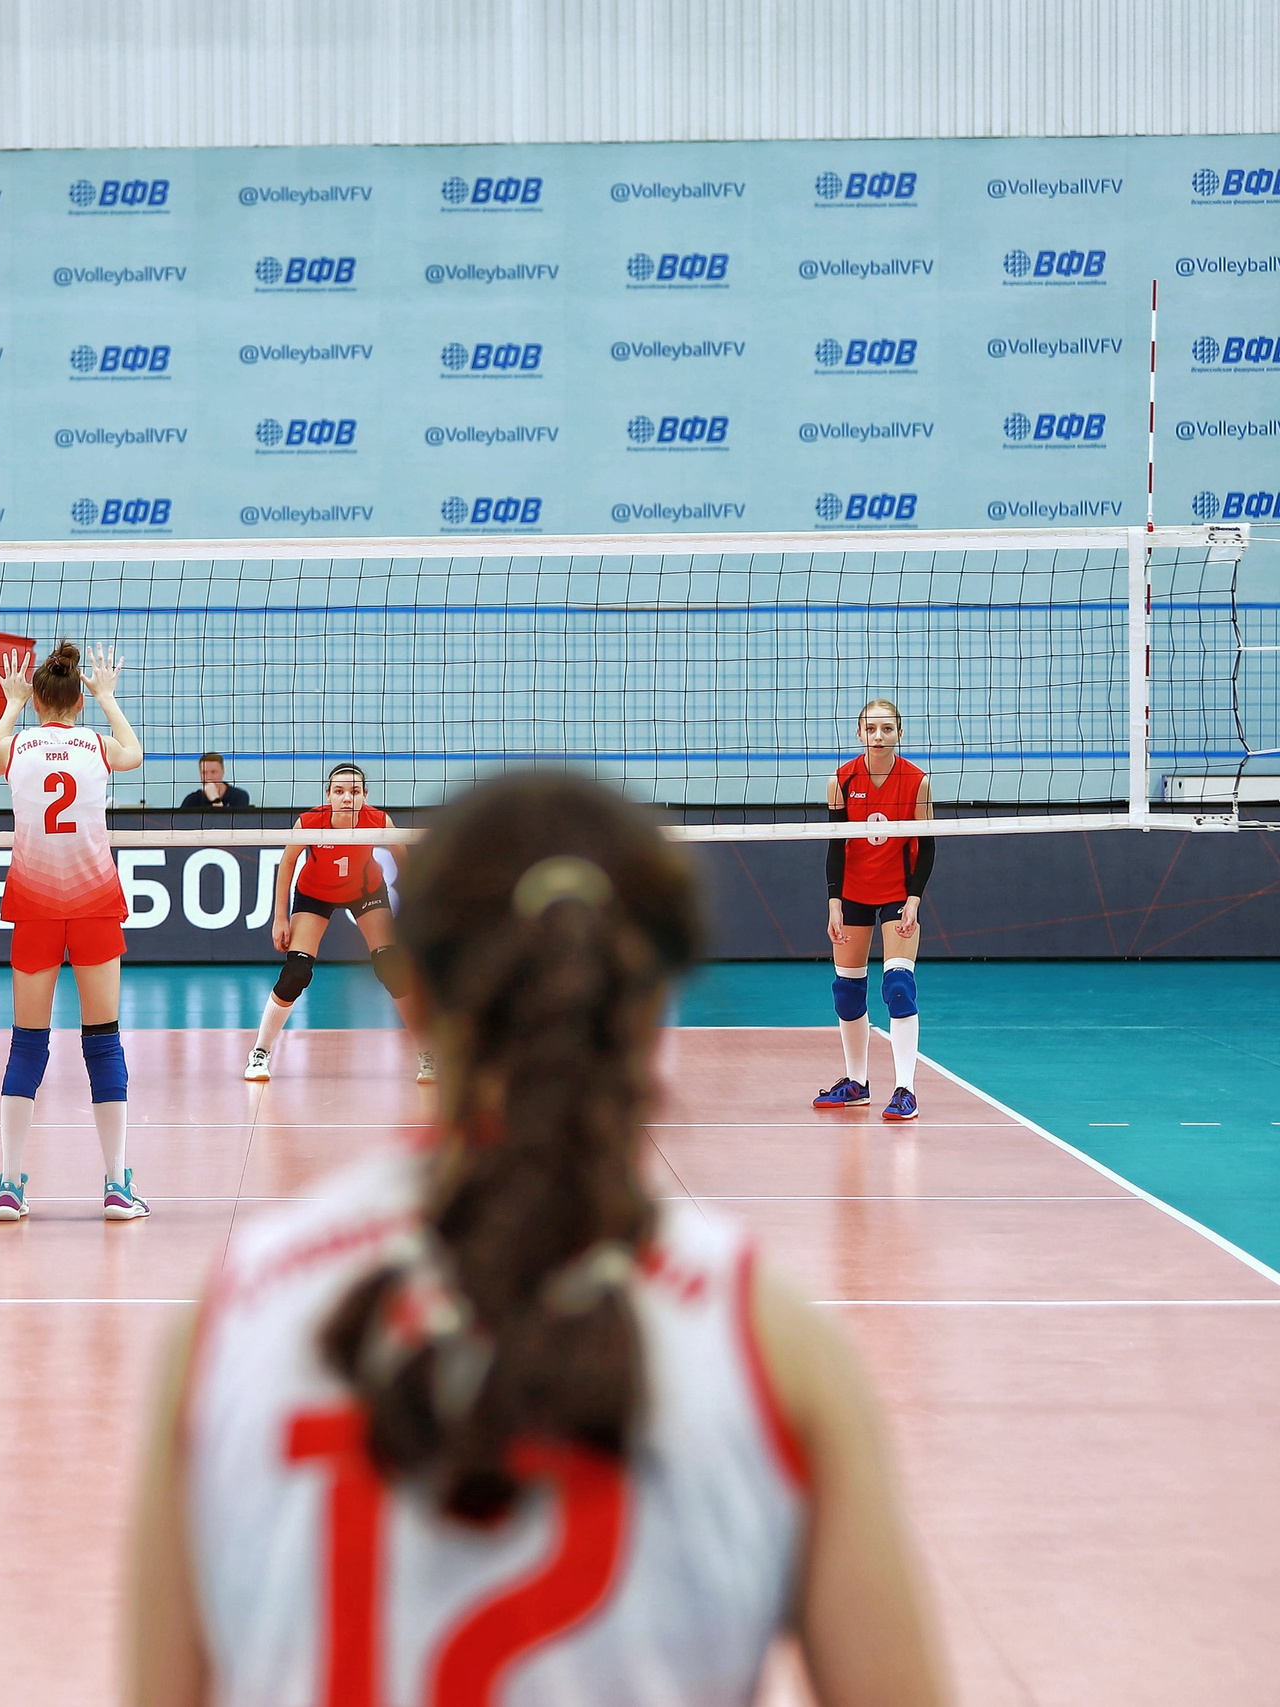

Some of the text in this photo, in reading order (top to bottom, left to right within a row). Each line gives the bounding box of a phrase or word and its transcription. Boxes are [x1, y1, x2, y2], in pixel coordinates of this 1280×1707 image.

[98, 179, 170, 207] ВФВ
[238, 186, 372, 206] @VolleyballVFV
[471, 177, 543, 205] ВФВ
[610, 182, 746, 203] @VolleyballVFV
[845, 171, 918, 199] ВФВ
[987, 178, 1123, 199] @VolleyballVFV
[284, 256, 357, 285] ВФВ
[424, 264, 559, 285] @VolleyballVFV
[656, 253, 729, 281] ВФВ
[798, 258, 934, 280] @VolleyballVFV
[1033, 250, 1107, 278] ВФВ
[53, 266, 187, 287] @VolleyballVFV
[99, 345, 171, 373] ВФВ
[239, 344, 373, 365] @VolleyballVFV
[470, 343, 543, 371] ВФВ
[610, 340, 745, 362] @VolleyballVFV
[844, 338, 918, 367] ВФВ
[987, 337, 1123, 358] @VolleyballVFV
[54, 427, 187, 448] @VolleyballVFV
[285, 418, 358, 446] ВФВ
[424, 426, 559, 447] @VolleyballVFV
[657, 415, 729, 444] ВФВ
[799, 422, 934, 443] @VolleyballVFV
[1033, 413, 1107, 441] ВФВ
[100, 498, 173, 526] ВФВ
[239, 505, 373, 526] @VolleyballVFV
[470, 497, 543, 524] ВФВ
[611, 502, 745, 523] @VolleyballVFV
[845, 493, 918, 521] ВФВ
[988, 500, 1123, 521] @VolleyballVFV
[45, 750, 70, 761] КРАЙ
[43, 770, 77, 835] 2
[333, 856, 349, 878] 1
[282, 1402, 632, 1707] 12
